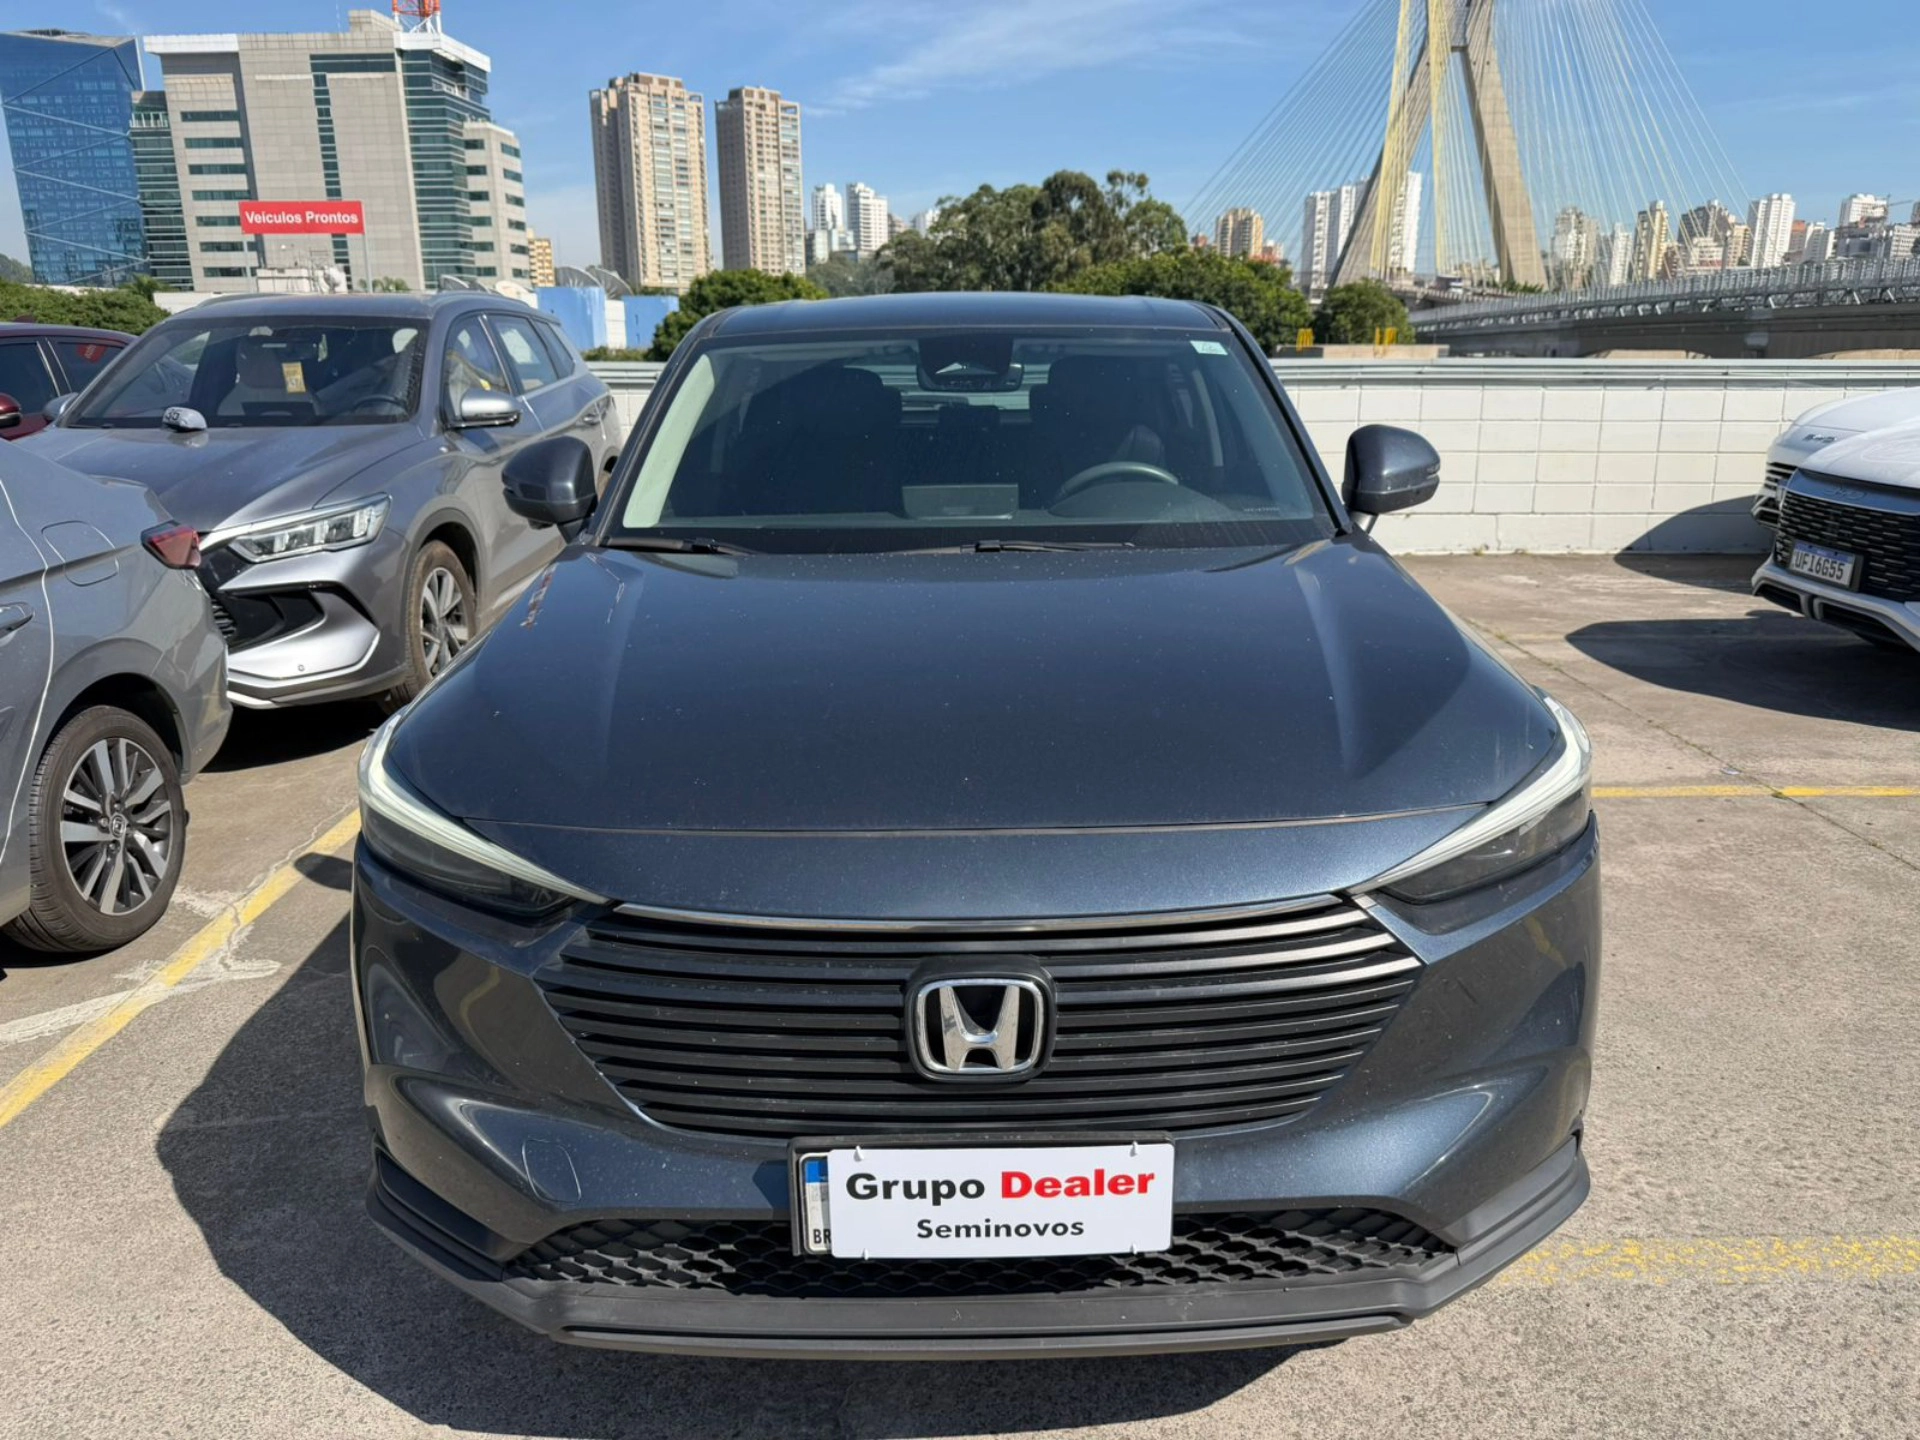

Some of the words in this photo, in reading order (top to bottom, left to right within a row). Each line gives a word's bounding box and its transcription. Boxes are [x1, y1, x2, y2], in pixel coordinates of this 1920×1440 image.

[246, 211, 302, 224] Veículos
[305, 211, 358, 224] Prontos
[845, 1174, 985, 1206] Grupo
[1001, 1169, 1155, 1198] Dealer
[917, 1219, 1085, 1240] Seminovos
